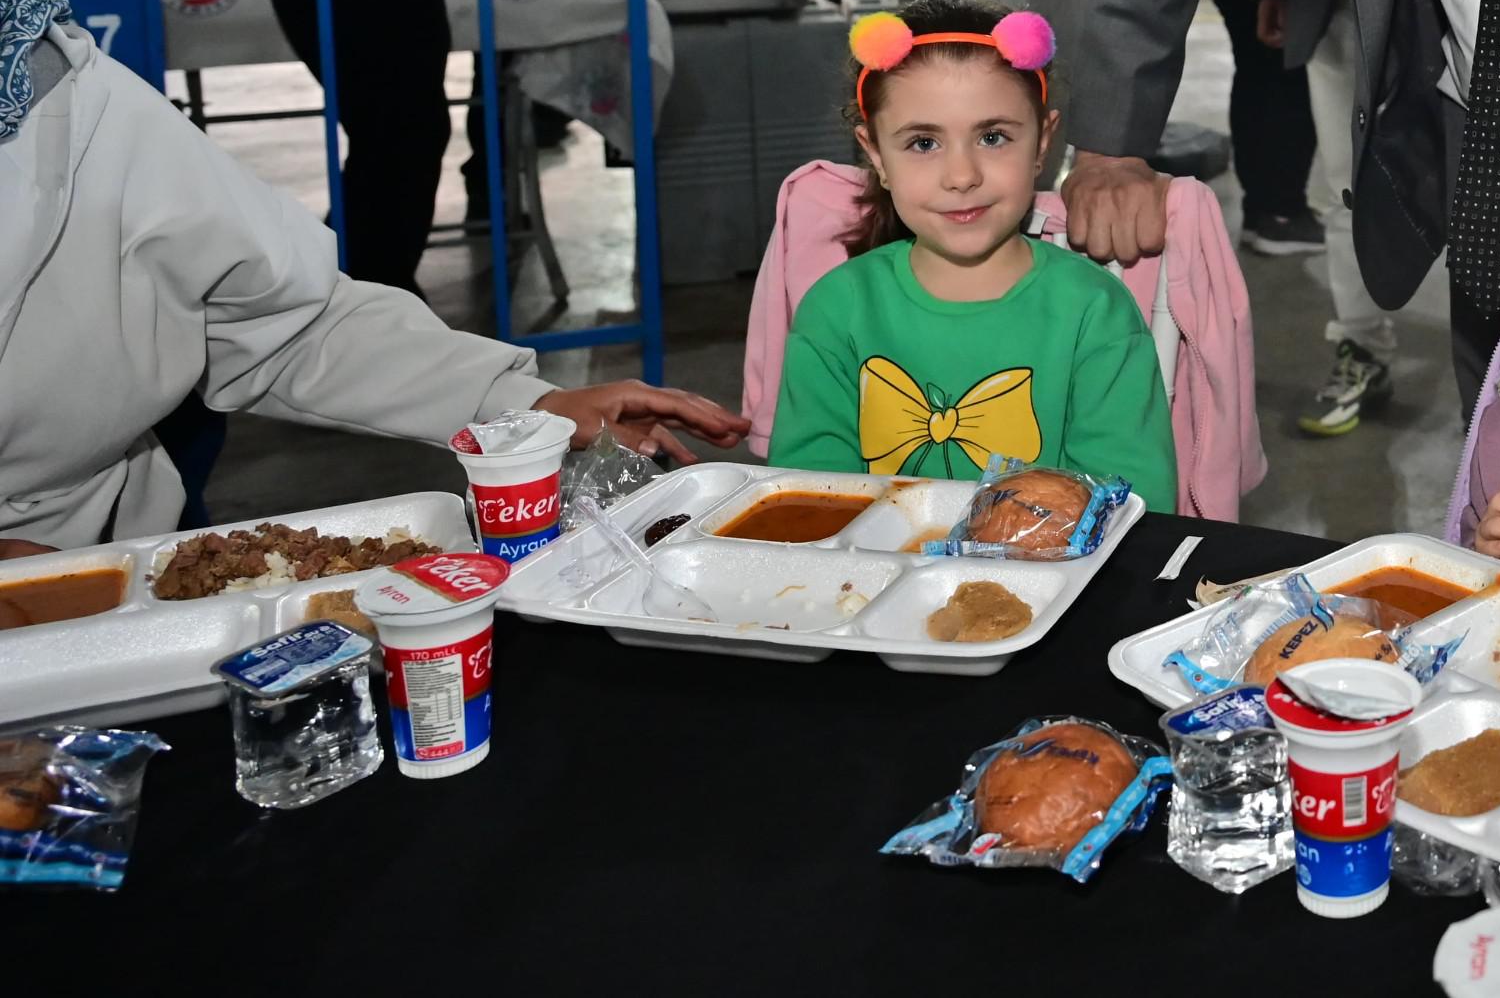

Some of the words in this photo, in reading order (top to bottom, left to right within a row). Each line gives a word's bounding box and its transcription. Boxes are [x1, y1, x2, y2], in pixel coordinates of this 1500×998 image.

[87, 14, 121, 55] 7
[499, 537, 548, 558] Ayran
[376, 585, 411, 605] Ayran
[251, 631, 304, 658] Safir
[1278, 620, 1318, 659] KEPEZ
[410, 651, 429, 661] 170
[1291, 776, 1337, 821] ker
